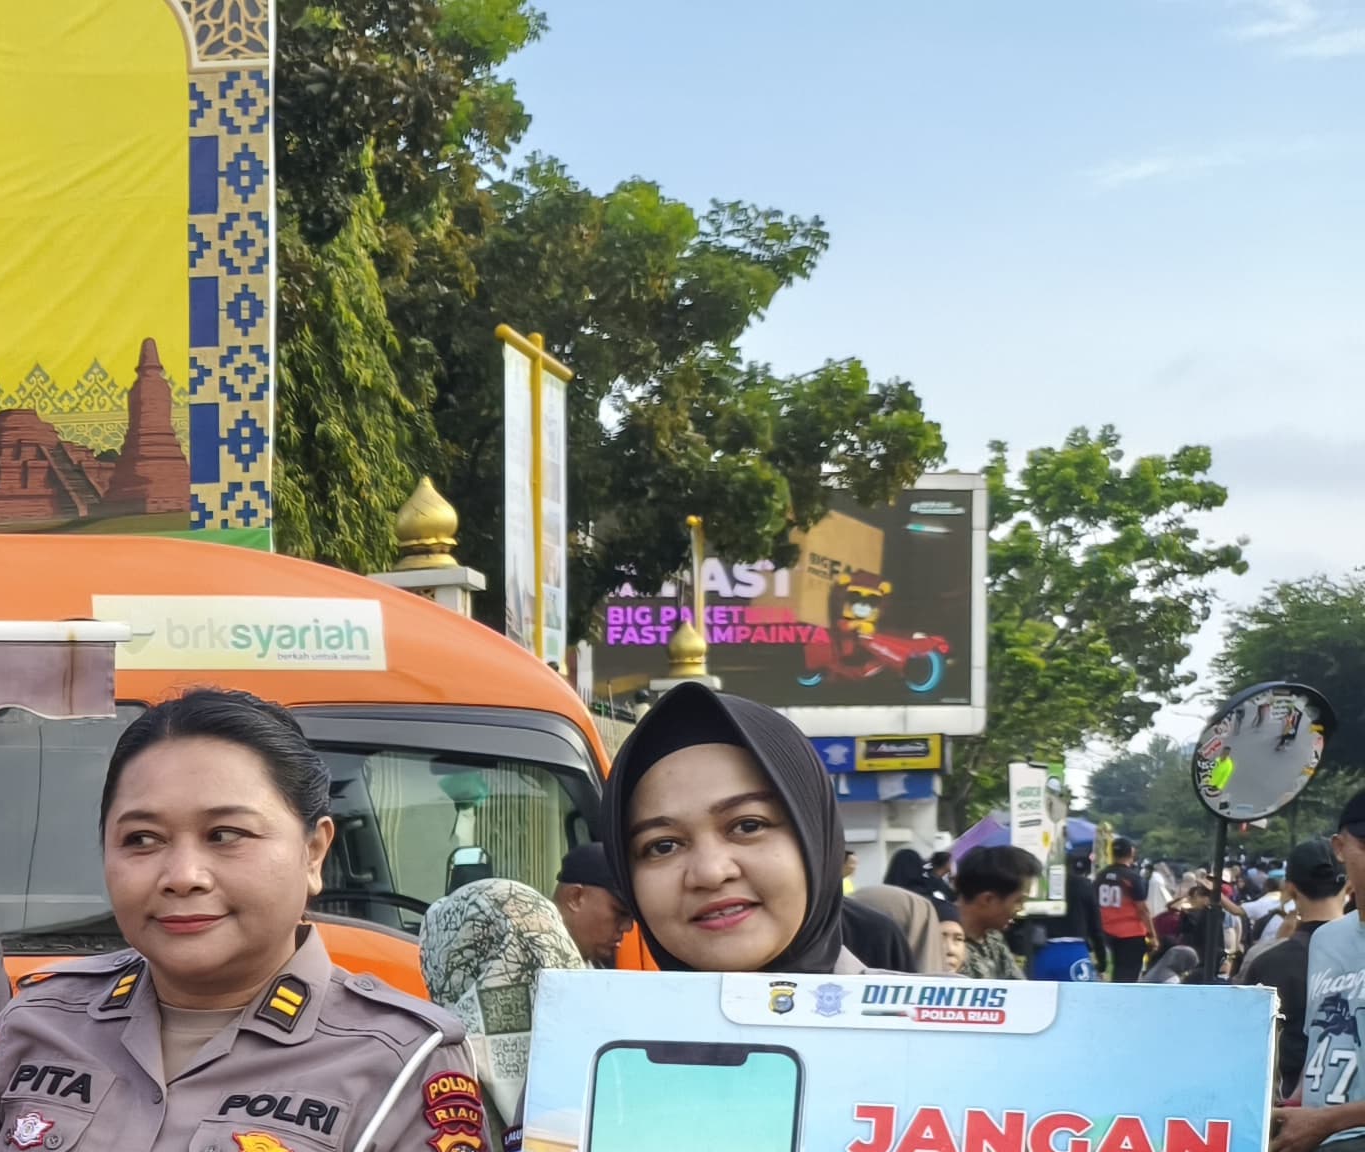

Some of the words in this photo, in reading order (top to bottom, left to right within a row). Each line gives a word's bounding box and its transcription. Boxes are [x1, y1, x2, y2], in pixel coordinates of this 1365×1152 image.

[607, 606, 652, 625] BIG
[607, 626, 672, 645] FAST
[1098, 884, 1123, 908] 80
[861, 983, 1009, 1009] DITLANTAS
[920, 1009, 965, 1021] POLDA
[967, 1011, 1000, 1023] RIAU
[1305, 1036, 1358, 1105] 47
[9, 1063, 92, 1104] PITA
[429, 1076, 476, 1100] POLDA
[218, 1093, 340, 1136] POLRI
[435, 1107, 478, 1121] RIAU
